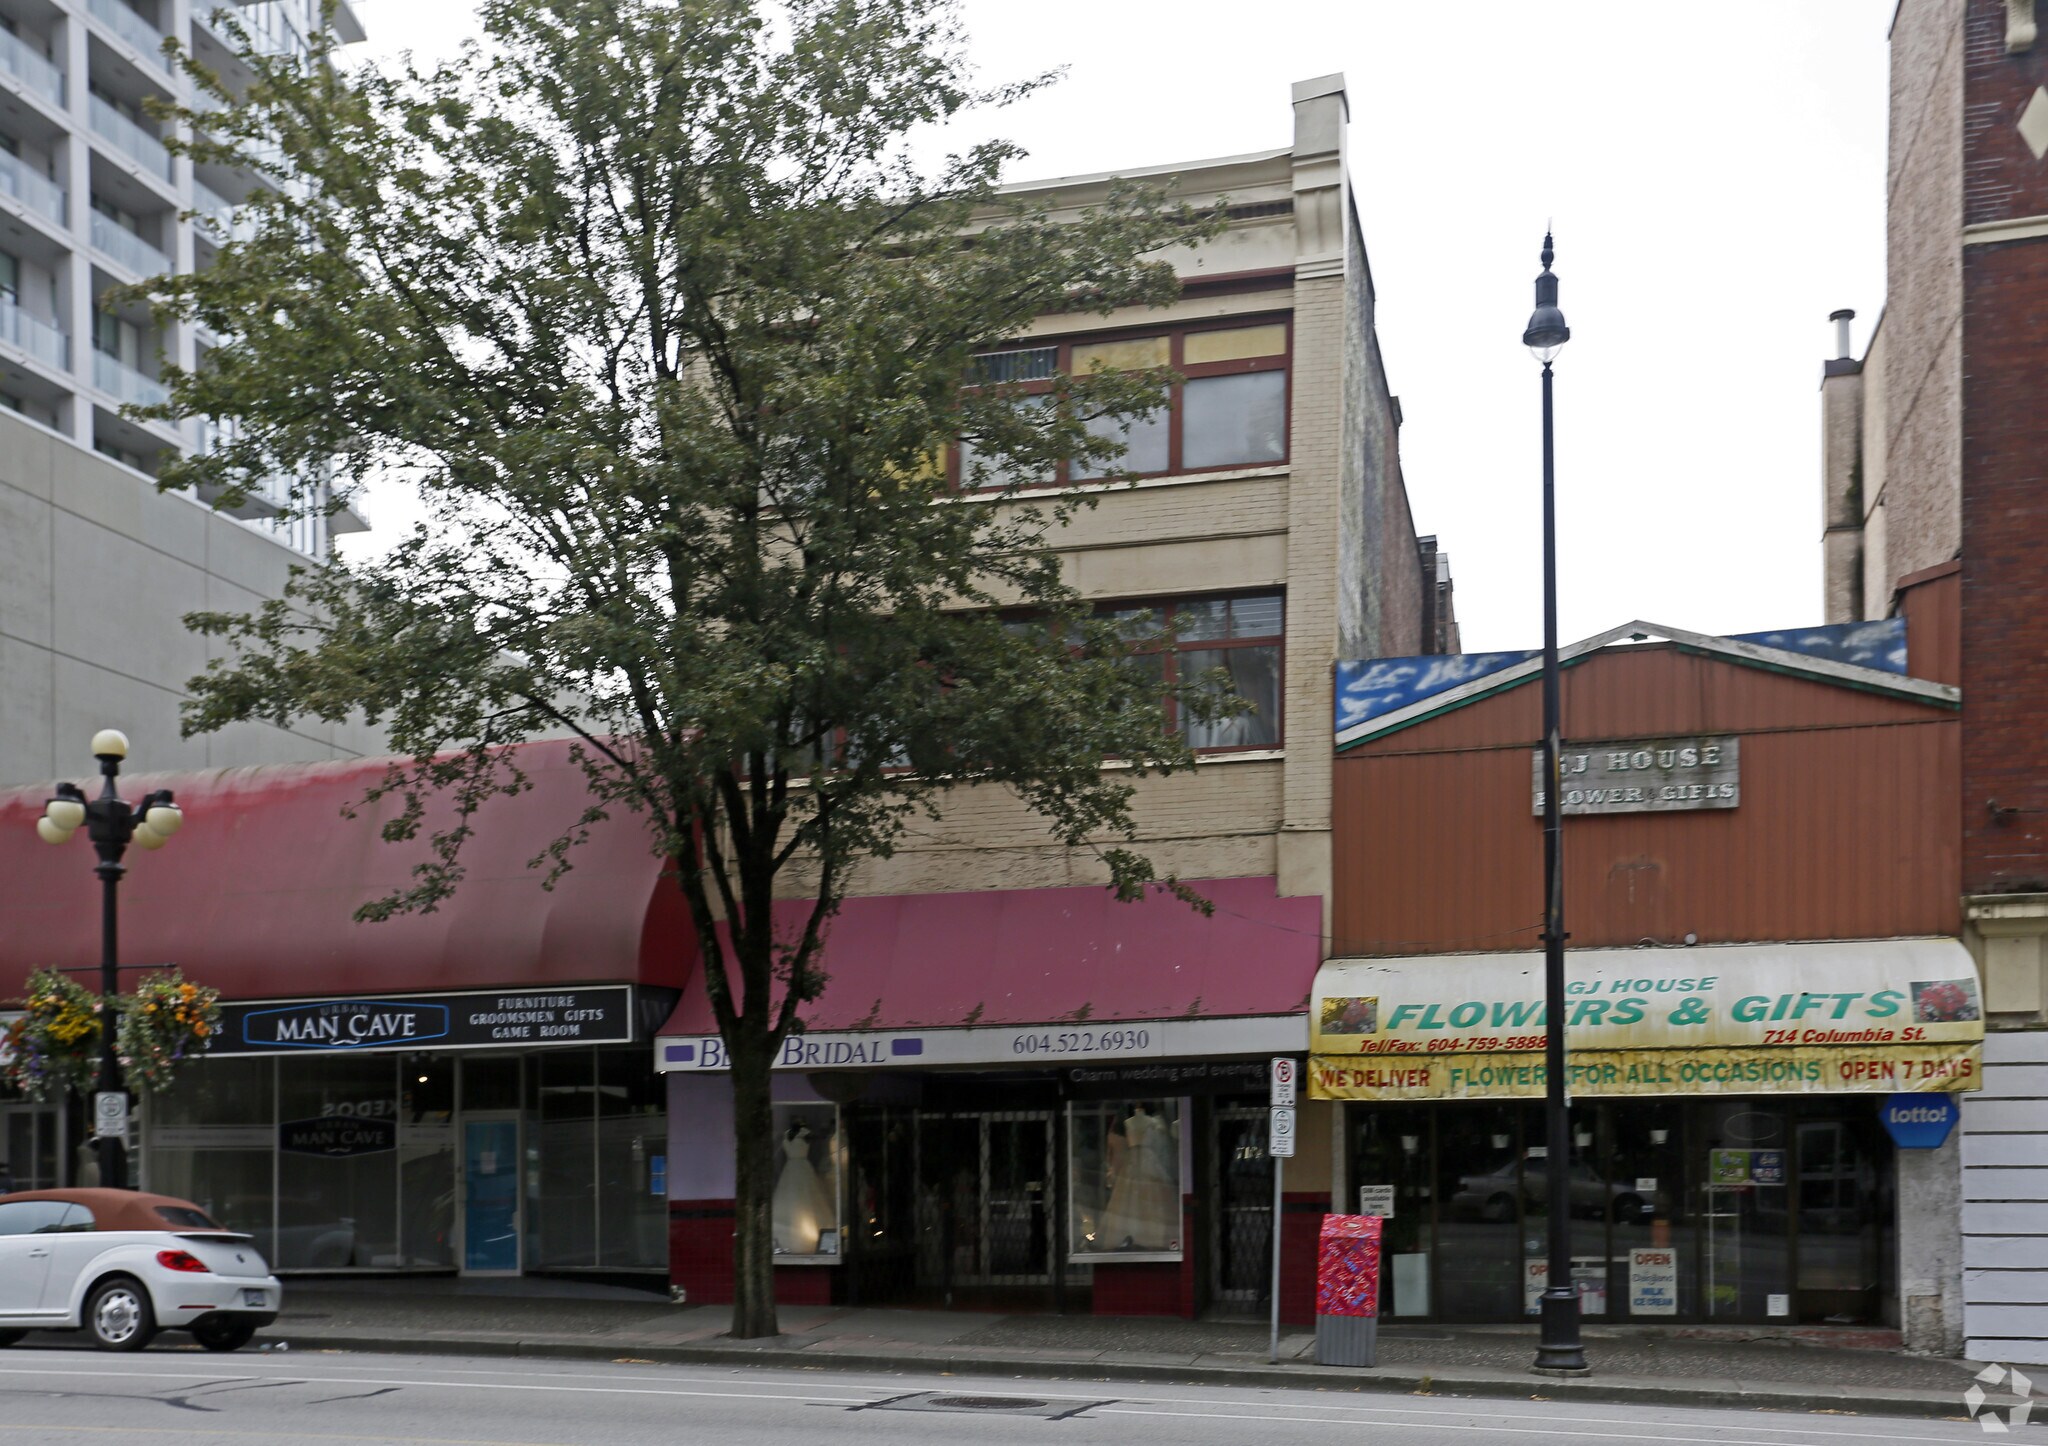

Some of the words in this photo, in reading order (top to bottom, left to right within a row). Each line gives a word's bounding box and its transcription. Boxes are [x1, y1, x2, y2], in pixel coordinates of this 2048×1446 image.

[1607, 746, 1720, 772] HOUSE
[1536, 787, 1644, 806] FOWER
[1659, 783, 1735, 800] GIFTS
[1567, 981, 1602, 995] GJ
[1609, 976, 1719, 994] HOUSE
[498, 996, 576, 1010] FURNITURE
[1668, 997, 1712, 1026] &
[1731, 989, 1907, 1023] GIFTS
[275, 1015, 339, 1041] MAN
[349, 1013, 416, 1037] CAVE
[470, 1011, 555, 1026] GROOMSMEN
[564, 1009, 604, 1021] GIFTS
[492, 1026, 530, 1039] GAME
[540, 1024, 581, 1037] ROOM
[1762, 1029, 1798, 1044] 714
[1802, 1027, 1895, 1044] Columbia
[1900, 1027, 1927, 1042] St.
[781, 1036, 888, 1066] BRIDAL
[1012, 1029, 1150, 1055] 604.522.6930
[1360, 1040, 1422, 1053] Tel/Fax:
[1427, 1035, 1548, 1052] 604-759-5888
[1070, 1068, 1117, 1083] Charm
[1119, 1064, 1178, 1083] wedding
[1181, 1062, 1207, 1077] and
[1210, 1062, 1265, 1081] evening
[1320, 1070, 1345, 1087] WE
[1354, 1069, 1430, 1087] DELIVER
[1451, 1066, 1568, 1087] FLOWER
[1571, 1064, 1616, 1085] FOR
[1627, 1064, 1671, 1084] ALL
[1680, 1061, 1821, 1083] OCCASIONS
[1840, 1060, 1895, 1080] OPEN
[1902, 1060, 1914, 1080] 7
[1921, 1058, 1973, 1079] DAYS
[292, 1131, 335, 1145] MAN
[340, 1130, 384, 1145] CAVE
[1635, 1253, 1671, 1265] OPEN
